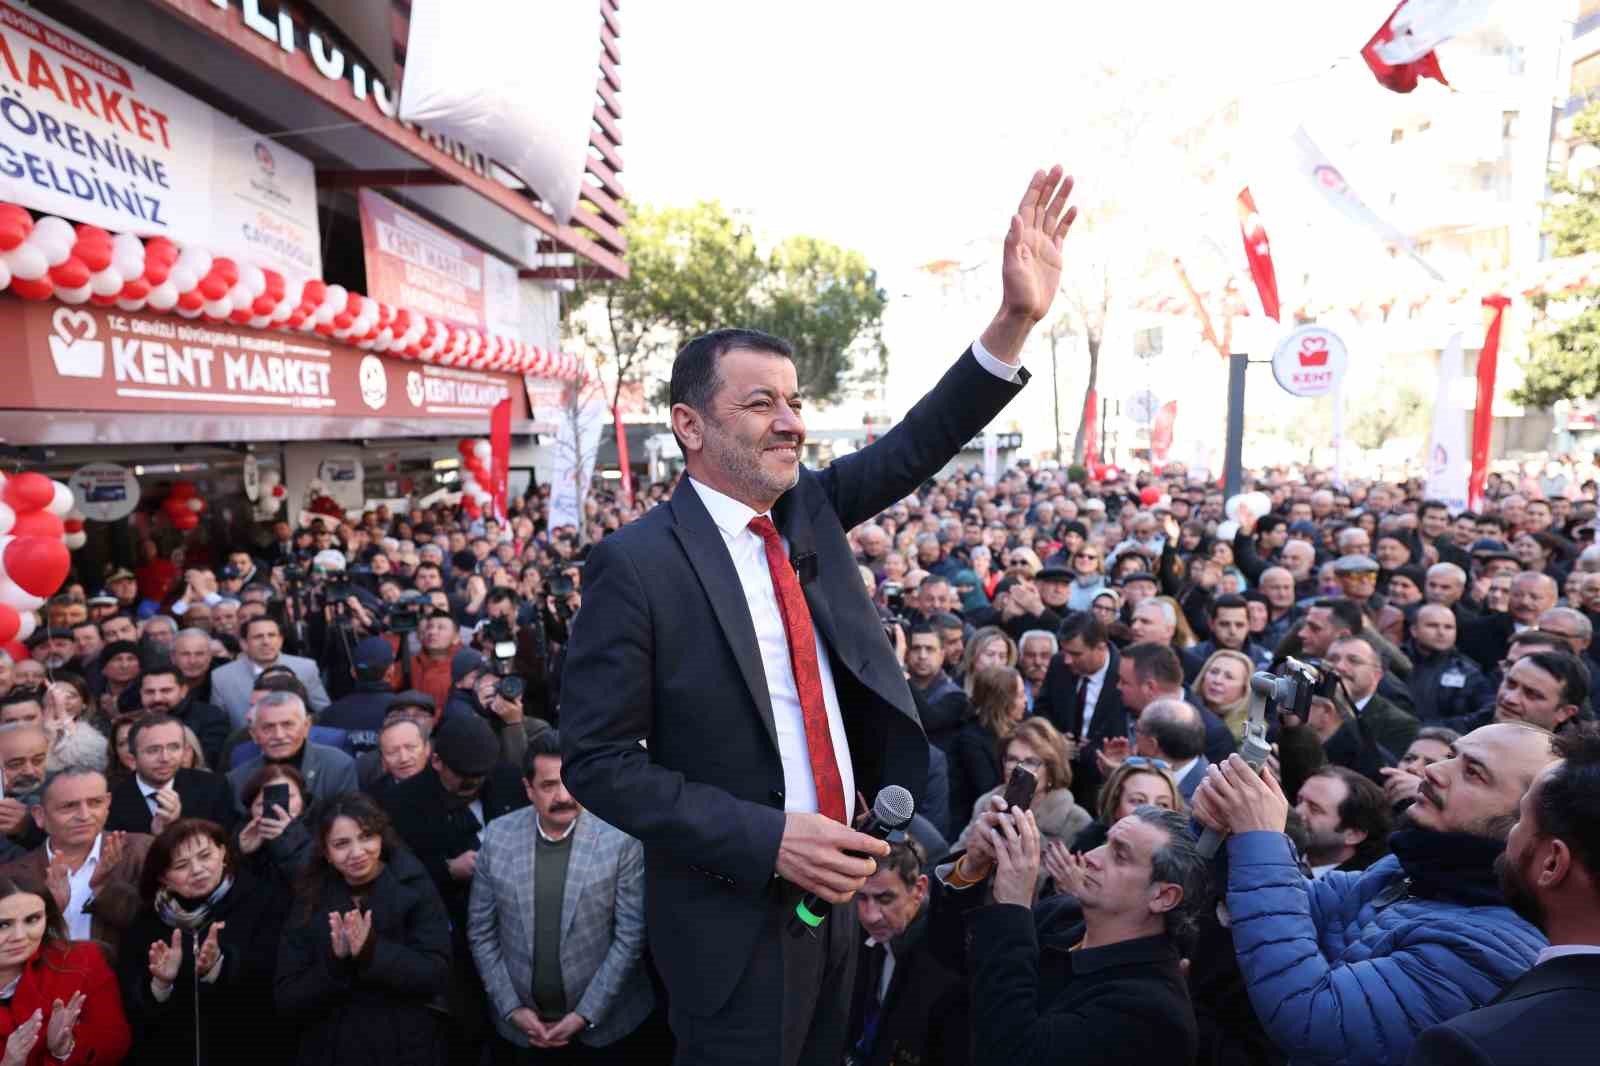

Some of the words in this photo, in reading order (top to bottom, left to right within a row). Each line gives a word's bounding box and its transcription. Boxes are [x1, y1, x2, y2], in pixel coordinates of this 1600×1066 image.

[0, 142, 168, 226] GELDİNİZ
[111, 336, 214, 387] KENT
[223, 351, 331, 395] MARKET
[1292, 371, 1332, 384] KENT
